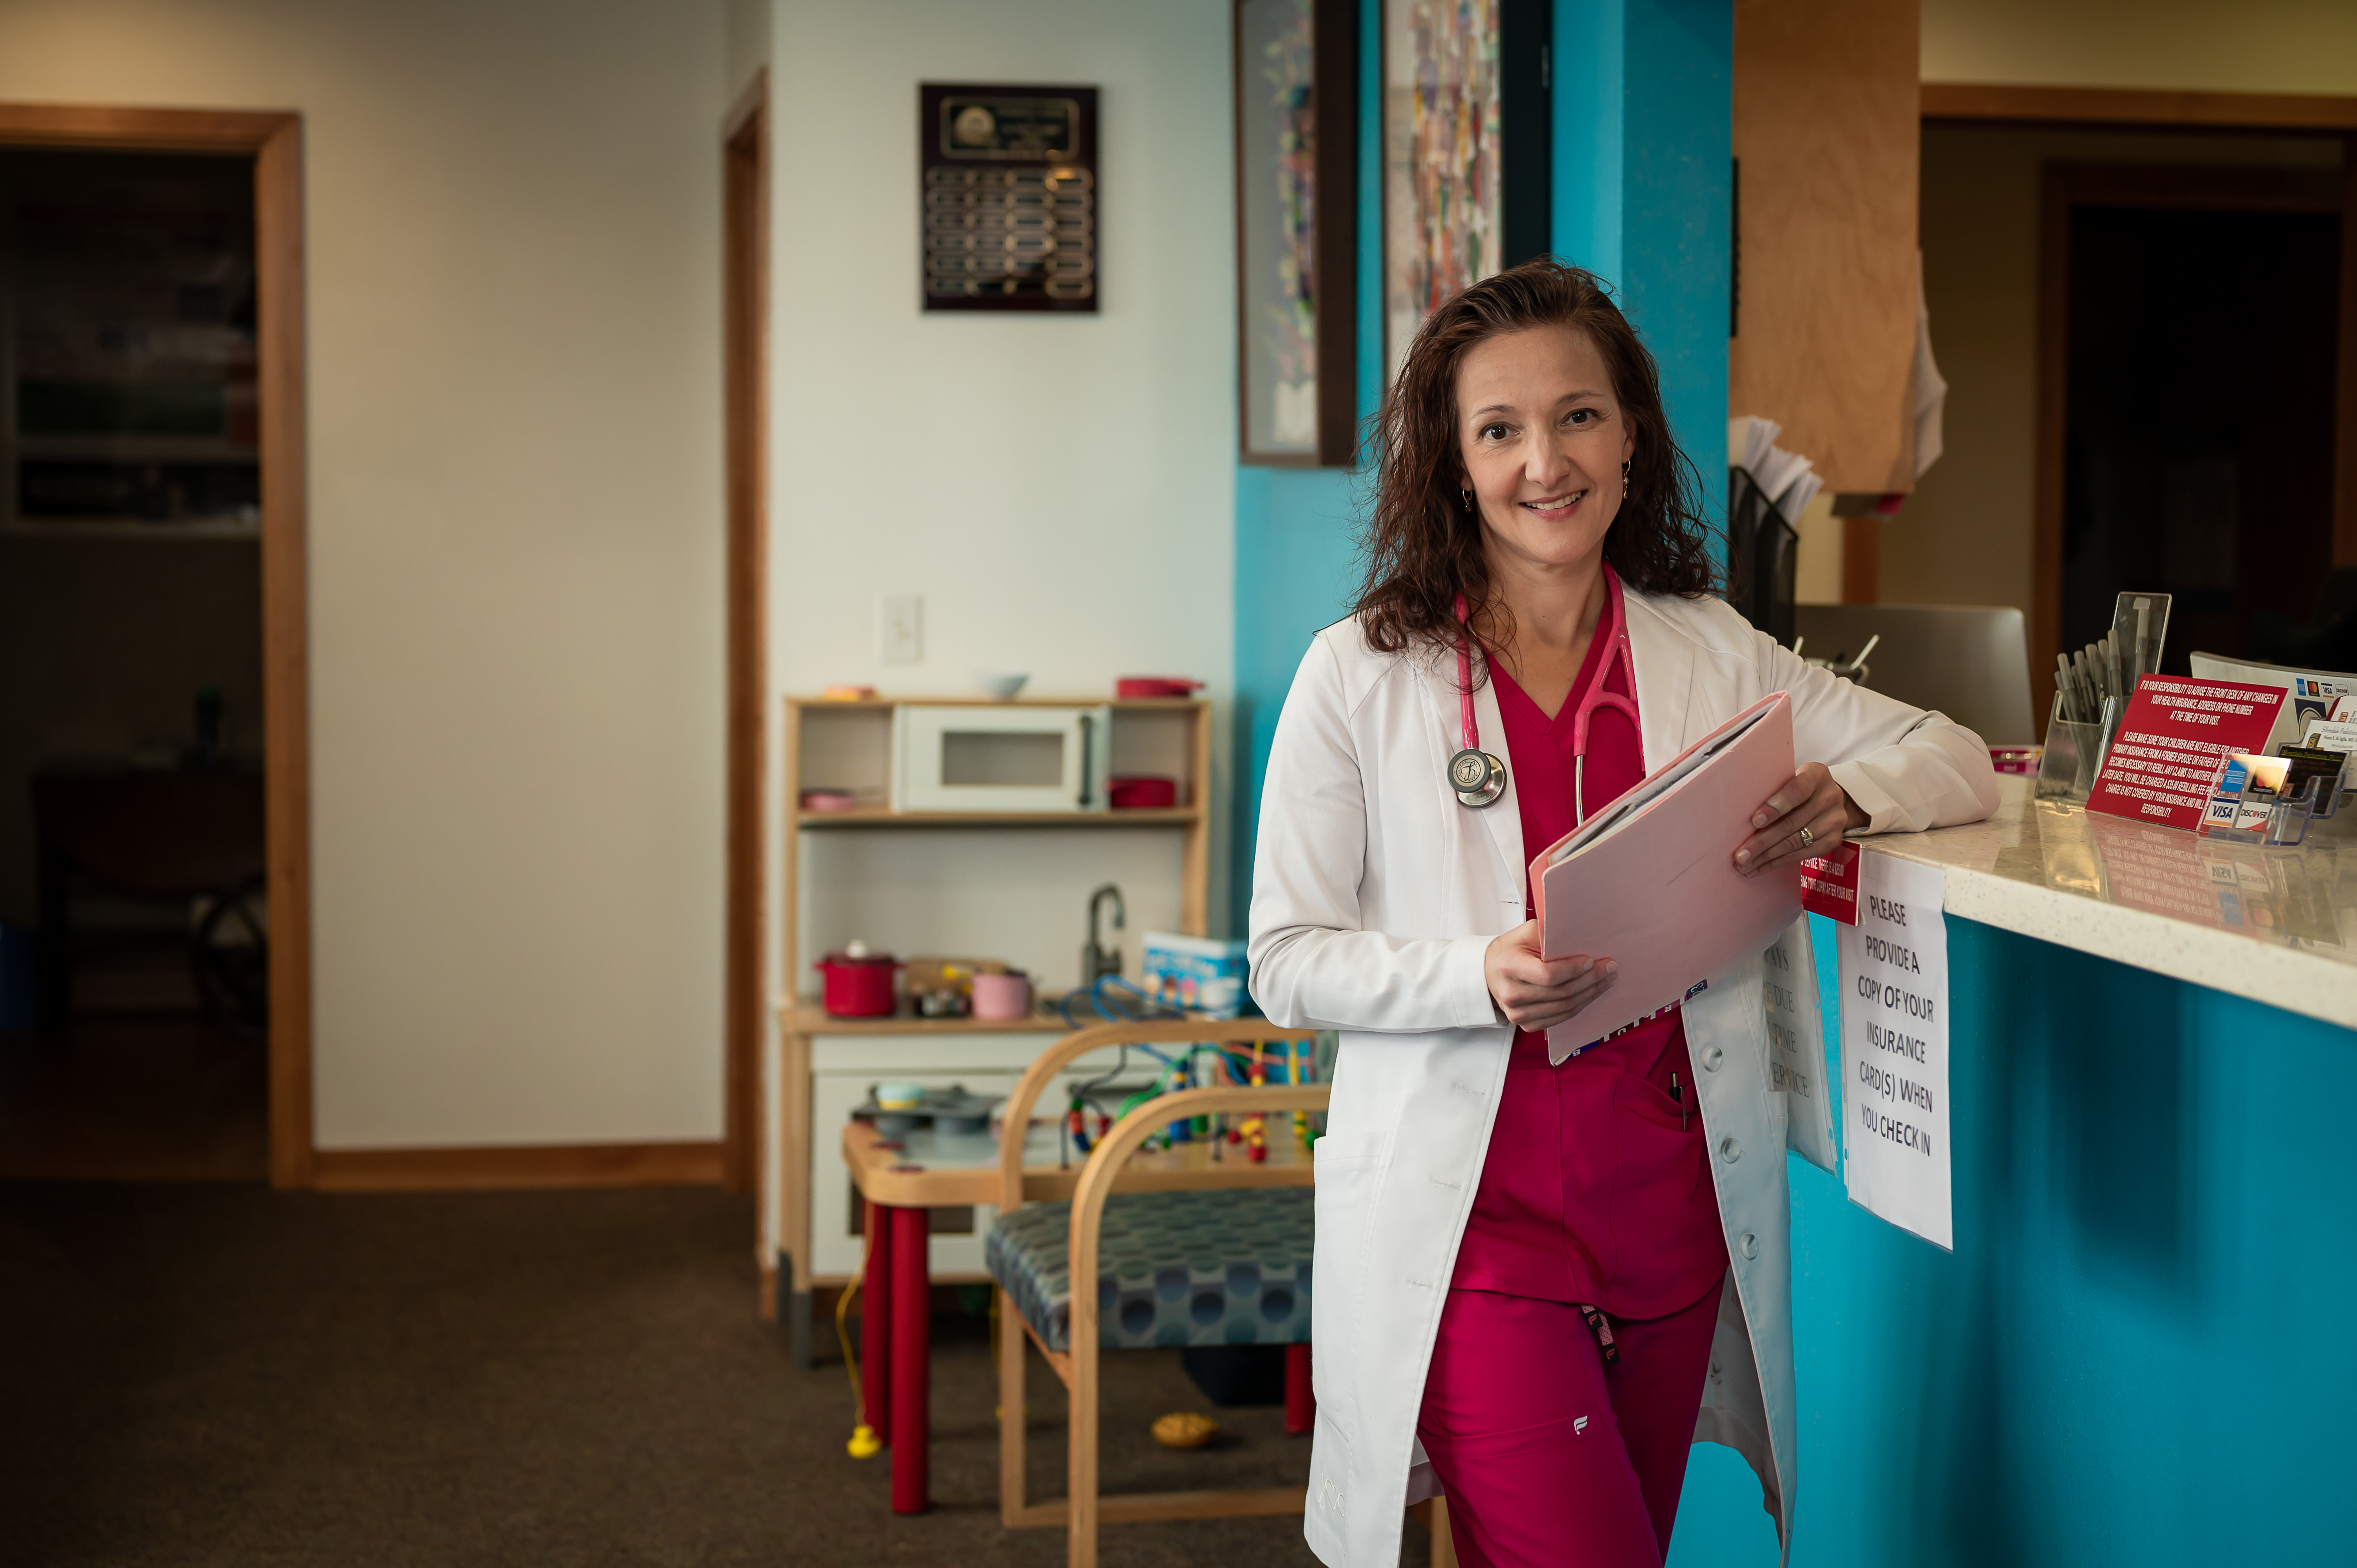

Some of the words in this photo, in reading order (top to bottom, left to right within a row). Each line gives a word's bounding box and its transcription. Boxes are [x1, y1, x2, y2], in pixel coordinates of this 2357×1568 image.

[2139, 680, 2146, 689] IT
[2143, 680, 2150, 690] IS
[2147, 681, 2159, 691] YOUR
[2157, 681, 2188, 694] RESPONSIBILITY
[2186, 685, 2194, 695] TO
[2190, 685, 2207, 696] ADVISE
[2205, 687, 2215, 697] THE
[2212, 688, 2229, 698] FRONT
[2225, 689, 2239, 700] DESK
[2237, 690, 2245, 700] OF
[2242, 691, 2254, 701] ANY
[2251, 692, 2274, 704] CHANGES
[2271, 694, 2279, 704] IN
[2151, 694, 2163, 705] YOUR
[2160, 696, 2177, 706] HEALTH
[2196, 700, 2217, 711] ADDRESS
[2215, 702, 2223, 712] OR
[2221, 702, 2237, 714] PHONE
[2234, 704, 2254, 716] NUMBER
[2169, 710, 2177, 720] AT
[2175, 711, 2185, 721] THE
[2183, 712, 2194, 722] TIME
[2192, 713, 2200, 723] OF
[2198, 714, 2210, 724] YOUR
[2112, 743, 2130, 754] PRIMARY
[2126, 745, 2149, 757] INSURANCE
[2146, 748, 2160, 759] FROM
[2157, 750, 2163, 759] A
[2160, 750, 2178, 762] FORMER
[2176, 753, 2194, 764] SPOUSE
[2191, 755, 2199, 765] OR
[2197, 756, 2214, 768] FATHER
[2212, 758, 2221, 768] OF
[2123, 731, 2139, 742] PLEASE
[2136, 733, 2149, 744] MAKE
[2146, 734, 2159, 745] SURE
[2157, 736, 2170, 747] YOUR
[2167, 737, 2188, 749] CHILDREN
[2185, 740, 2196, 751] ARE
[2193, 741, 2205, 751] NOT
[2201, 742, 2222, 754] ELIGIBLE
[2108, 756, 2127, 768] BECOMES
[2124, 758, 2148, 771] NECESSARY
[2146, 762, 2153, 772] TO
[2151, 762, 2165, 774] REBILL
[2163, 765, 2175, 775] ANY
[2172, 766, 2188, 778] CLAIMS
[2186, 768, 2194, 779] TO
[2191, 769, 2212, 781] ANOTHER
[2102, 769, 2115, 780] LATER
[2123, 772, 2133, 782] YOU
[2131, 773, 2141, 784] WILL
[2139, 775, 2148, 785] BE
[2145, 775, 2165, 788] CHARGED
[2162, 779, 2168, 788] A
[2177, 781, 2199, 794] REBILLING
[2196, 784, 2207, 795] FEE
[2105, 783, 2122, 795] CHARGE
[2119, 785, 2126, 795] IS
[2123, 786, 2133, 796] NOT
[2131, 787, 2150, 799] COVERED
[2148, 790, 2157, 800] BY
[2154, 791, 2166, 802] YOUR
[2164, 793, 2188, 806] INSURANCE
[2185, 797, 2196, 808] AND
[2194, 799, 2205, 810] WILL
[2212, 805, 2234, 819] VISA
[2240, 809, 2267, 819] DISCOVER
[1818, 858, 1829, 872] THERE
[1828, 861, 1832, 874] IS
[1808, 876, 1816, 891] YOUR
[1816, 879, 1827, 894] COPAY
[1826, 882, 1836, 897] AFTER
[1836, 885, 1846, 899] YOUR
[1870, 895, 1906, 927] PLEASE
[1866, 935, 1909, 971] PROVIDE
[1912, 951, 1921, 975] A
[1773, 984, 1795, 1013] DUE
[1858, 975, 1882, 1004] COPY
[1884, 985, 1901, 1010] OF
[1902, 990, 1934, 1023] YOUR
[1772, 1023, 1797, 1053] TIME
[1867, 1020, 1926, 1064] INSURANCE
[1772, 1062, 1809, 1098] ERVICE
[1860, 1060, 1895, 1103] CARD(S)
[1899, 1077, 1933, 1113] WHEN
[1862, 1103, 1878, 1133] YOU
[1880, 1115, 1919, 1150] CHECK
[1921, 1130, 1930, 1157] IN
